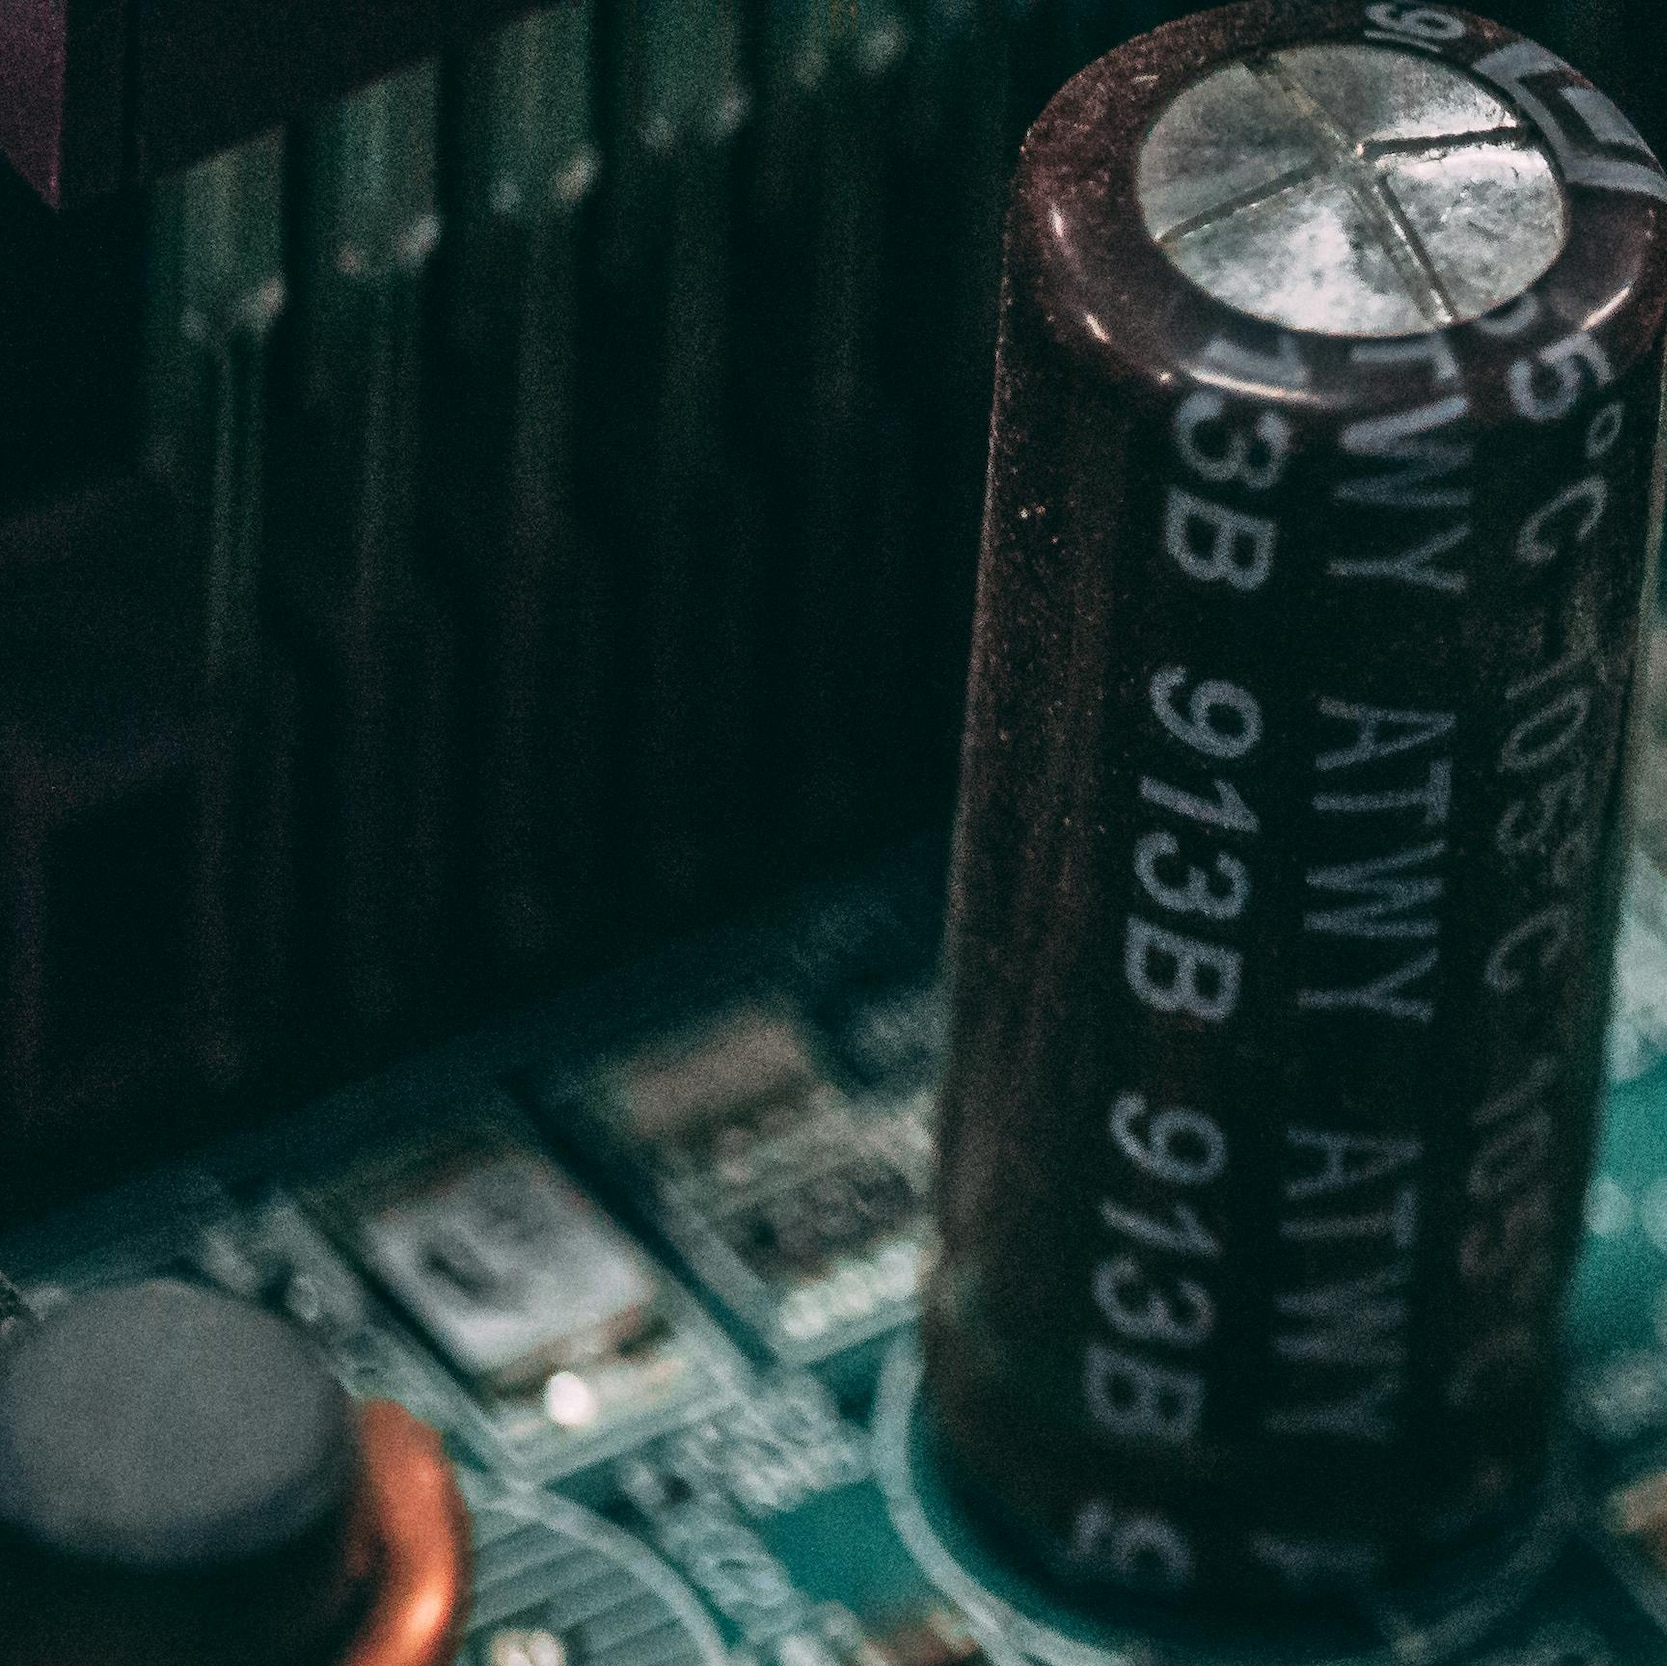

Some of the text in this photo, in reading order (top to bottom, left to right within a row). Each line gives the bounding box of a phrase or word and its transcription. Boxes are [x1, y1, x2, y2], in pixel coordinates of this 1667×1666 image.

[1122, 666, 1263, 1022] 913B
[1297, 696, 1458, 1024] ATWY
[1082, 1088, 1229, 1444] 913B
[1264, 1126, 1426, 1442] ATWY
